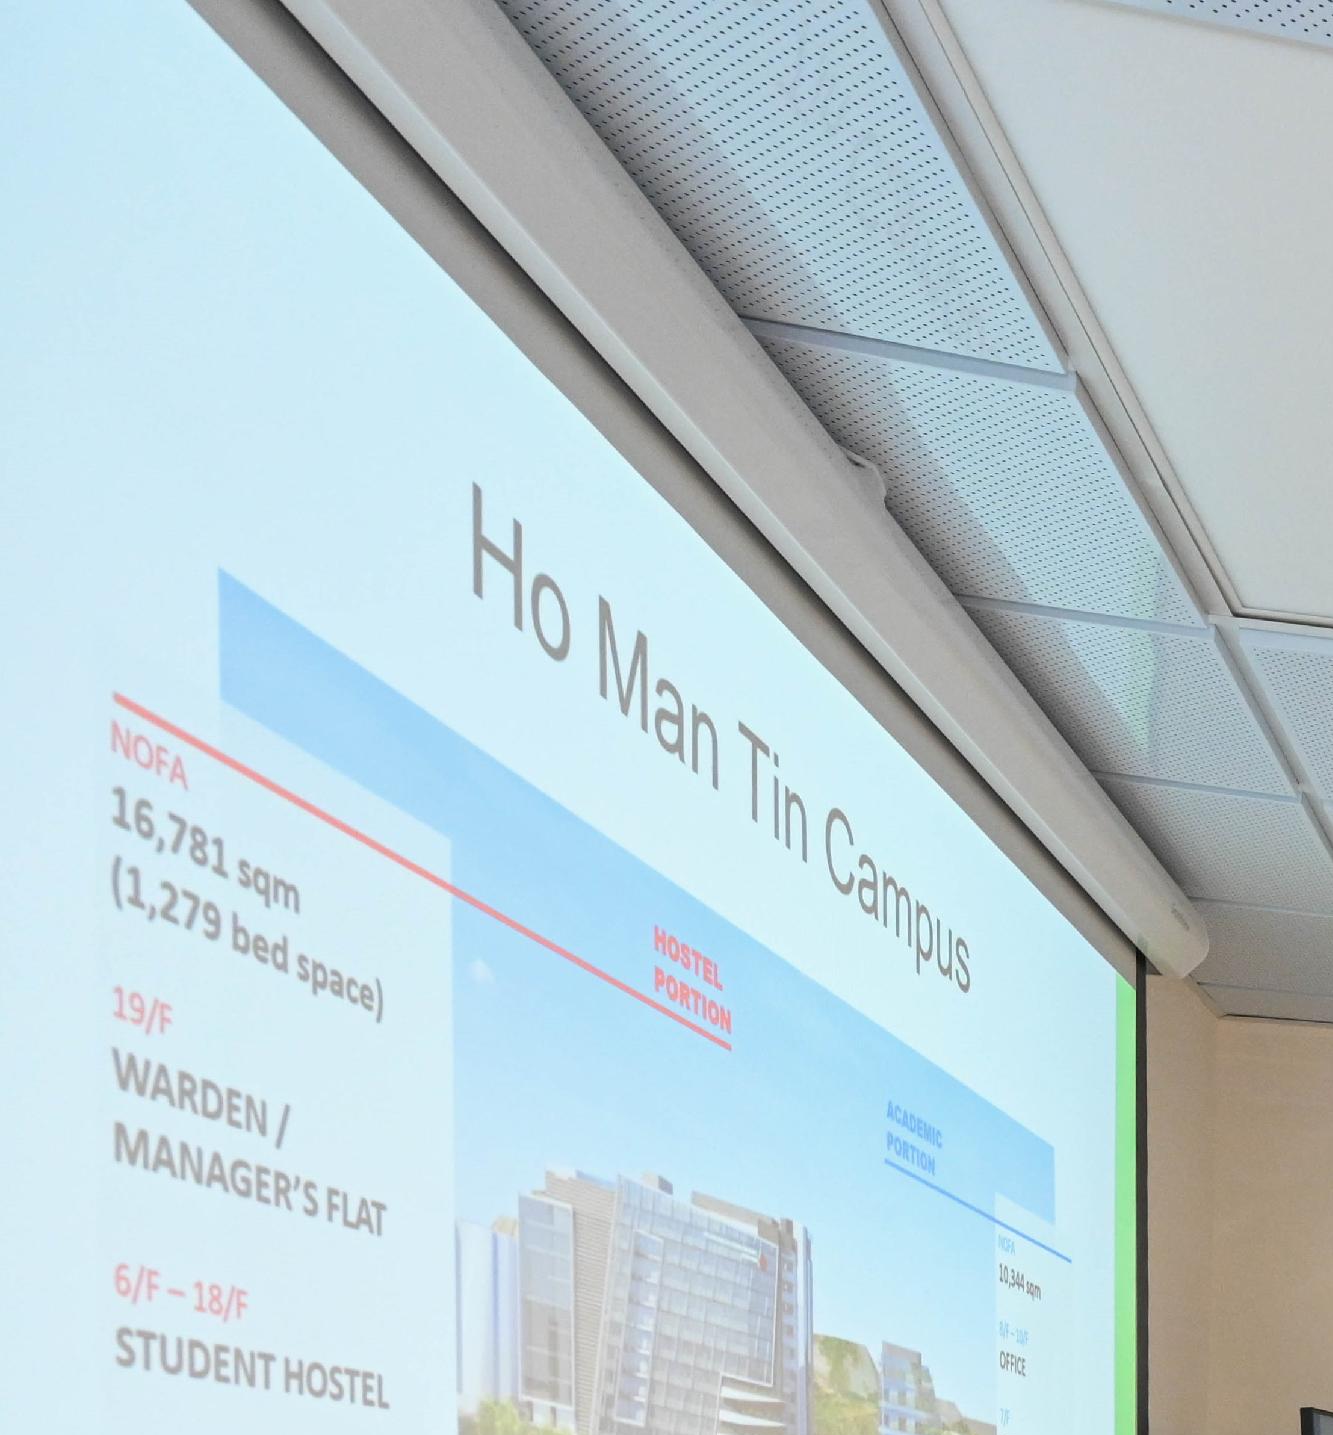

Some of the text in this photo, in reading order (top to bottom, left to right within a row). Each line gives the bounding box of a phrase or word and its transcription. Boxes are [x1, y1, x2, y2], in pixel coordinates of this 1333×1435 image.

[110, 719, 189, 791] NOFA
[472, 481, 971, 994] Ho Man Tin Campus
[112, 786, 300, 915] 16,781 sqm
[112, 855, 383, 1024] (1,279 bed space)
[653, 924, 724, 991] HOSTEL
[113, 985, 173, 1036] 19/F
[653, 966, 732, 1034] PORTION
[112, 1046, 290, 1150] WARDEN /
[886, 1100, 943, 1149] ACADEMIC
[114, 1120, 388, 1238] MANAGER'S FLAT
[886, 1131, 936, 1177] PORTION
[114, 1262, 249, 1323] 6/F 18/F
[1025, 1280, 1042, 1301] sqm
[115, 1326, 391, 1410] STUDENT HOSTEL
[999, 1350, 1026, 1377] OFFICE
